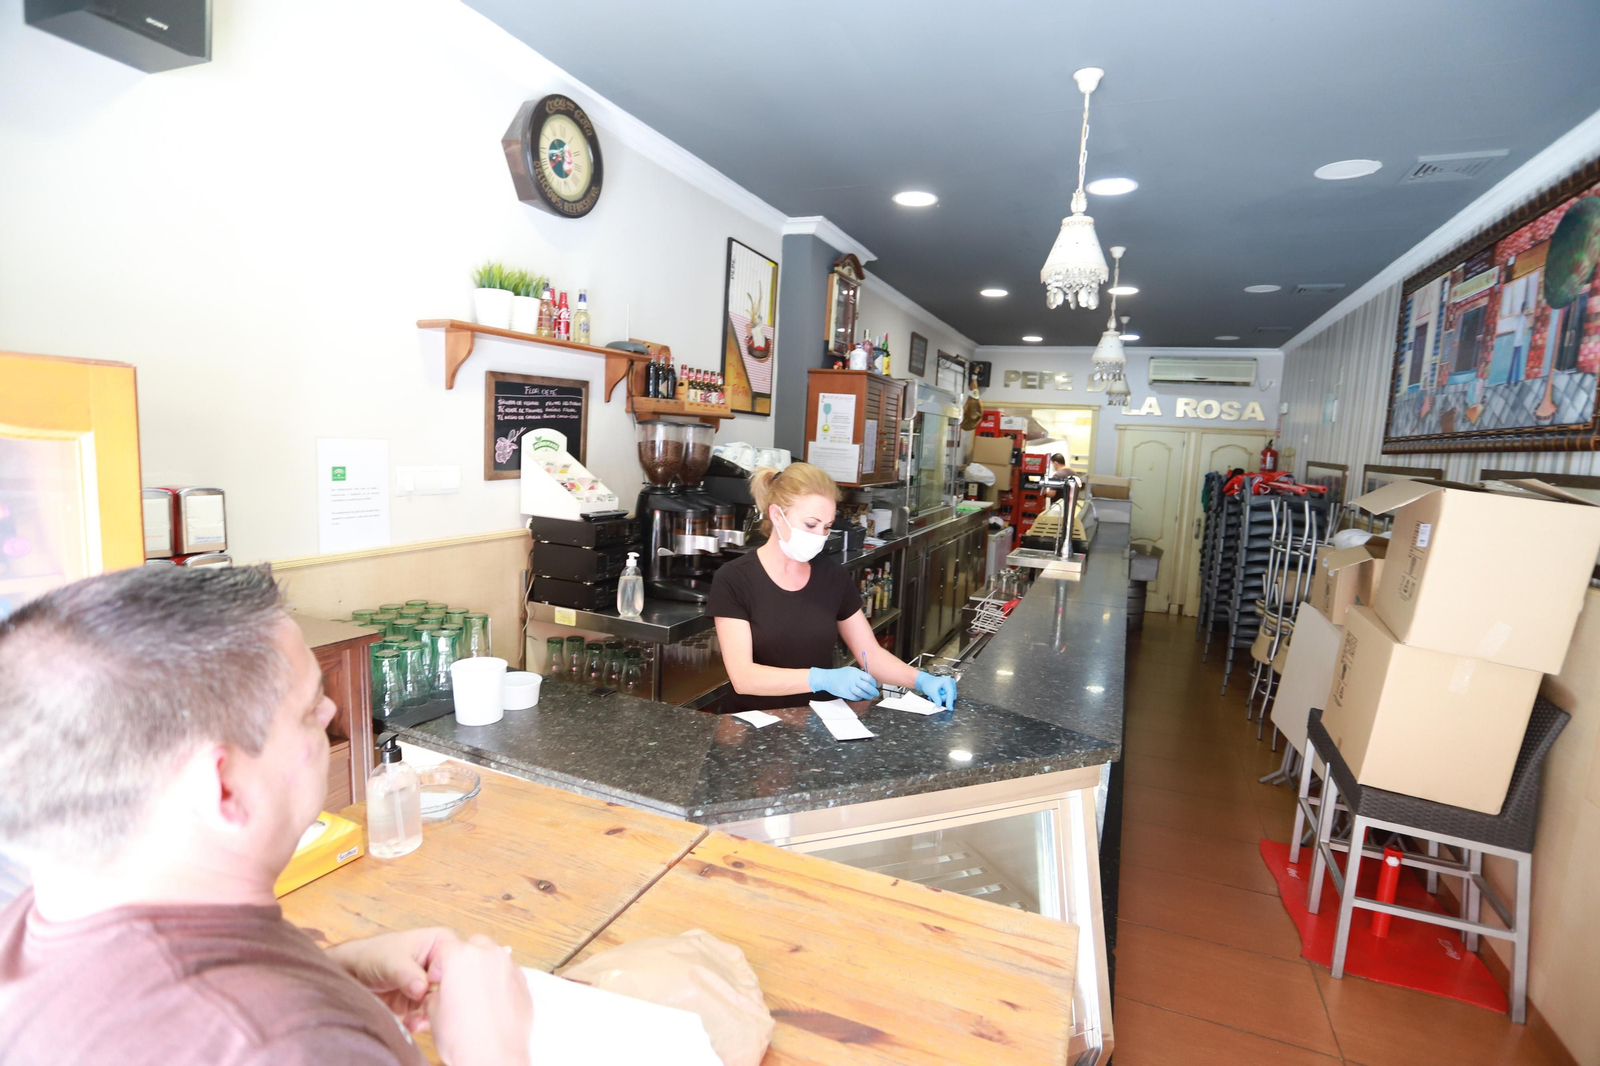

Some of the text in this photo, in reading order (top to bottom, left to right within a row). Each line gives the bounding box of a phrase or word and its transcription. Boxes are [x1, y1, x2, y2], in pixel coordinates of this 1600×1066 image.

[1004, 369, 1074, 391] PEPE
[1121, 396, 1266, 422] LA ROSA
